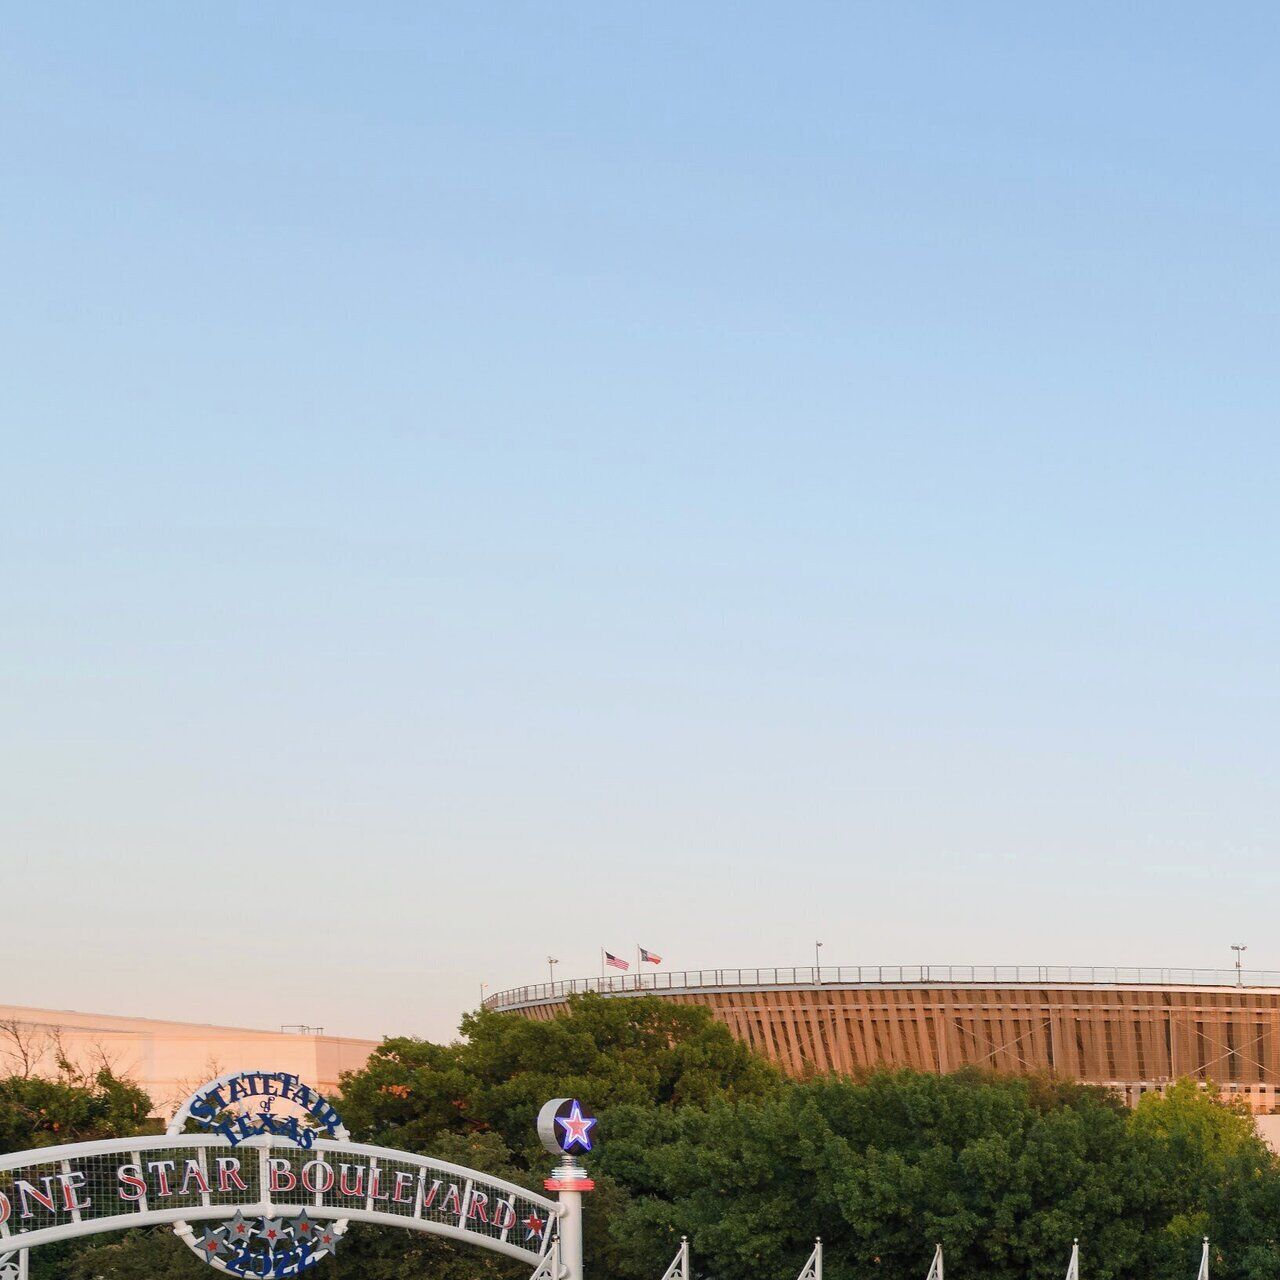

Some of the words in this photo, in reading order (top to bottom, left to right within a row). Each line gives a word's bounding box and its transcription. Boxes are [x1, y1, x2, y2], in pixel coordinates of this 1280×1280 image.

[190, 1071, 278, 1128] STATE
[276, 1072, 343, 1135] FAIR
[260, 1096, 276, 1112] of
[213, 1112, 319, 1149] TEXAS
[116, 1156, 249, 1200] STAR
[267, 1158, 517, 1230] BOULEVARD
[225, 1243, 320, 1280] 2022
